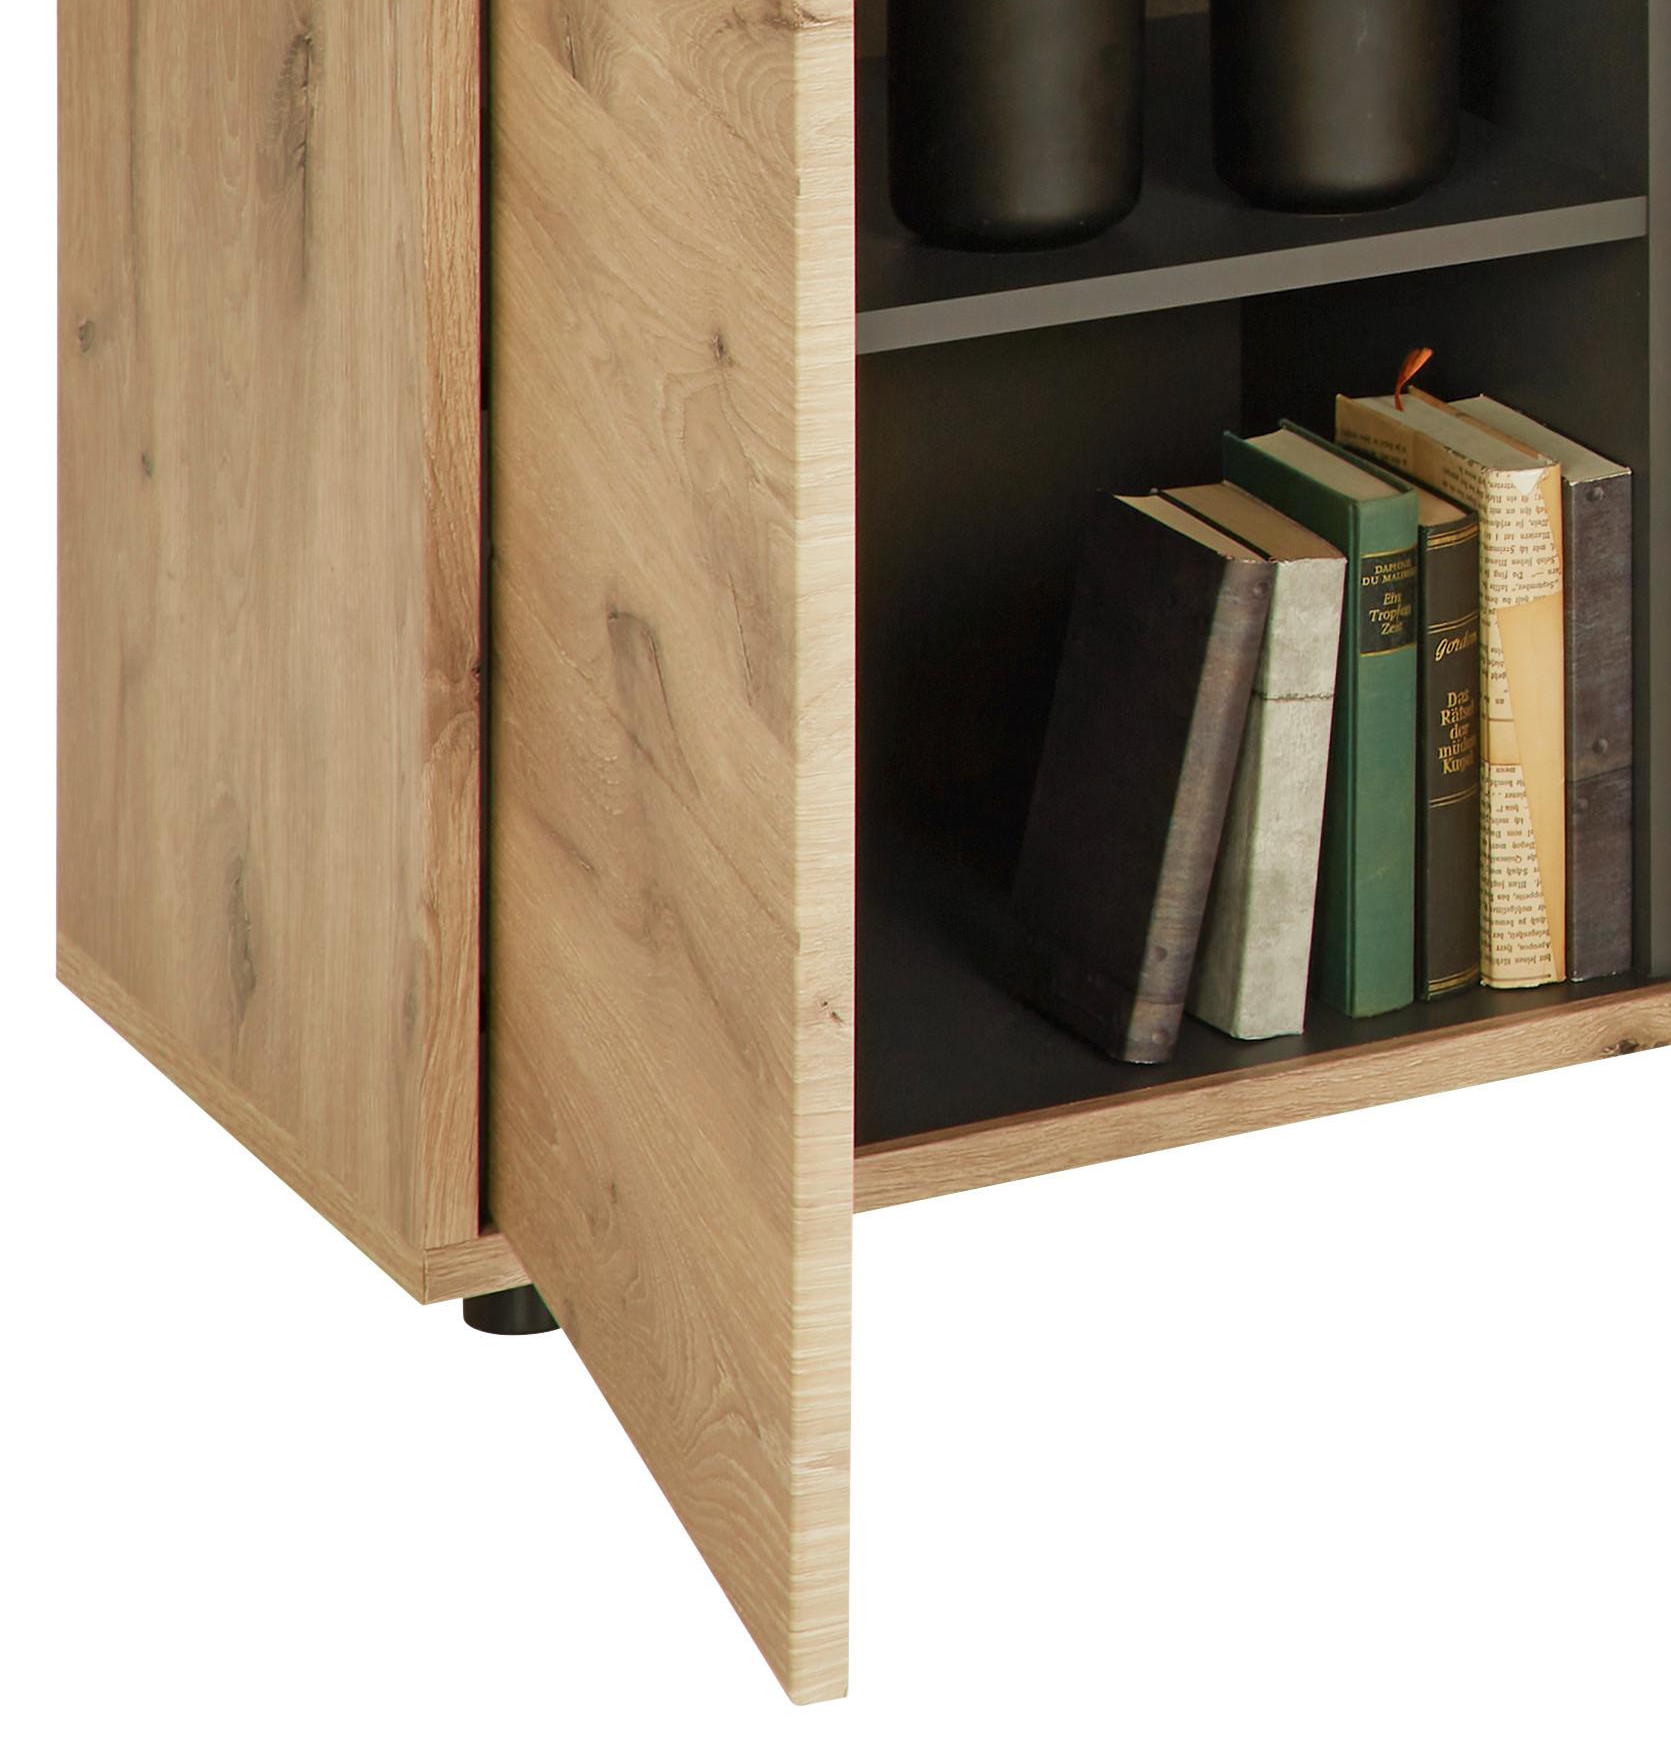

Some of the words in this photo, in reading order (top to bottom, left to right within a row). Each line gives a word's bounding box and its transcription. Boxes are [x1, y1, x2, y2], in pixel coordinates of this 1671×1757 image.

[1362, 576, 1379, 586] DU
[1383, 592, 1402, 606] Ein
[1447, 690, 1470, 708] Das
